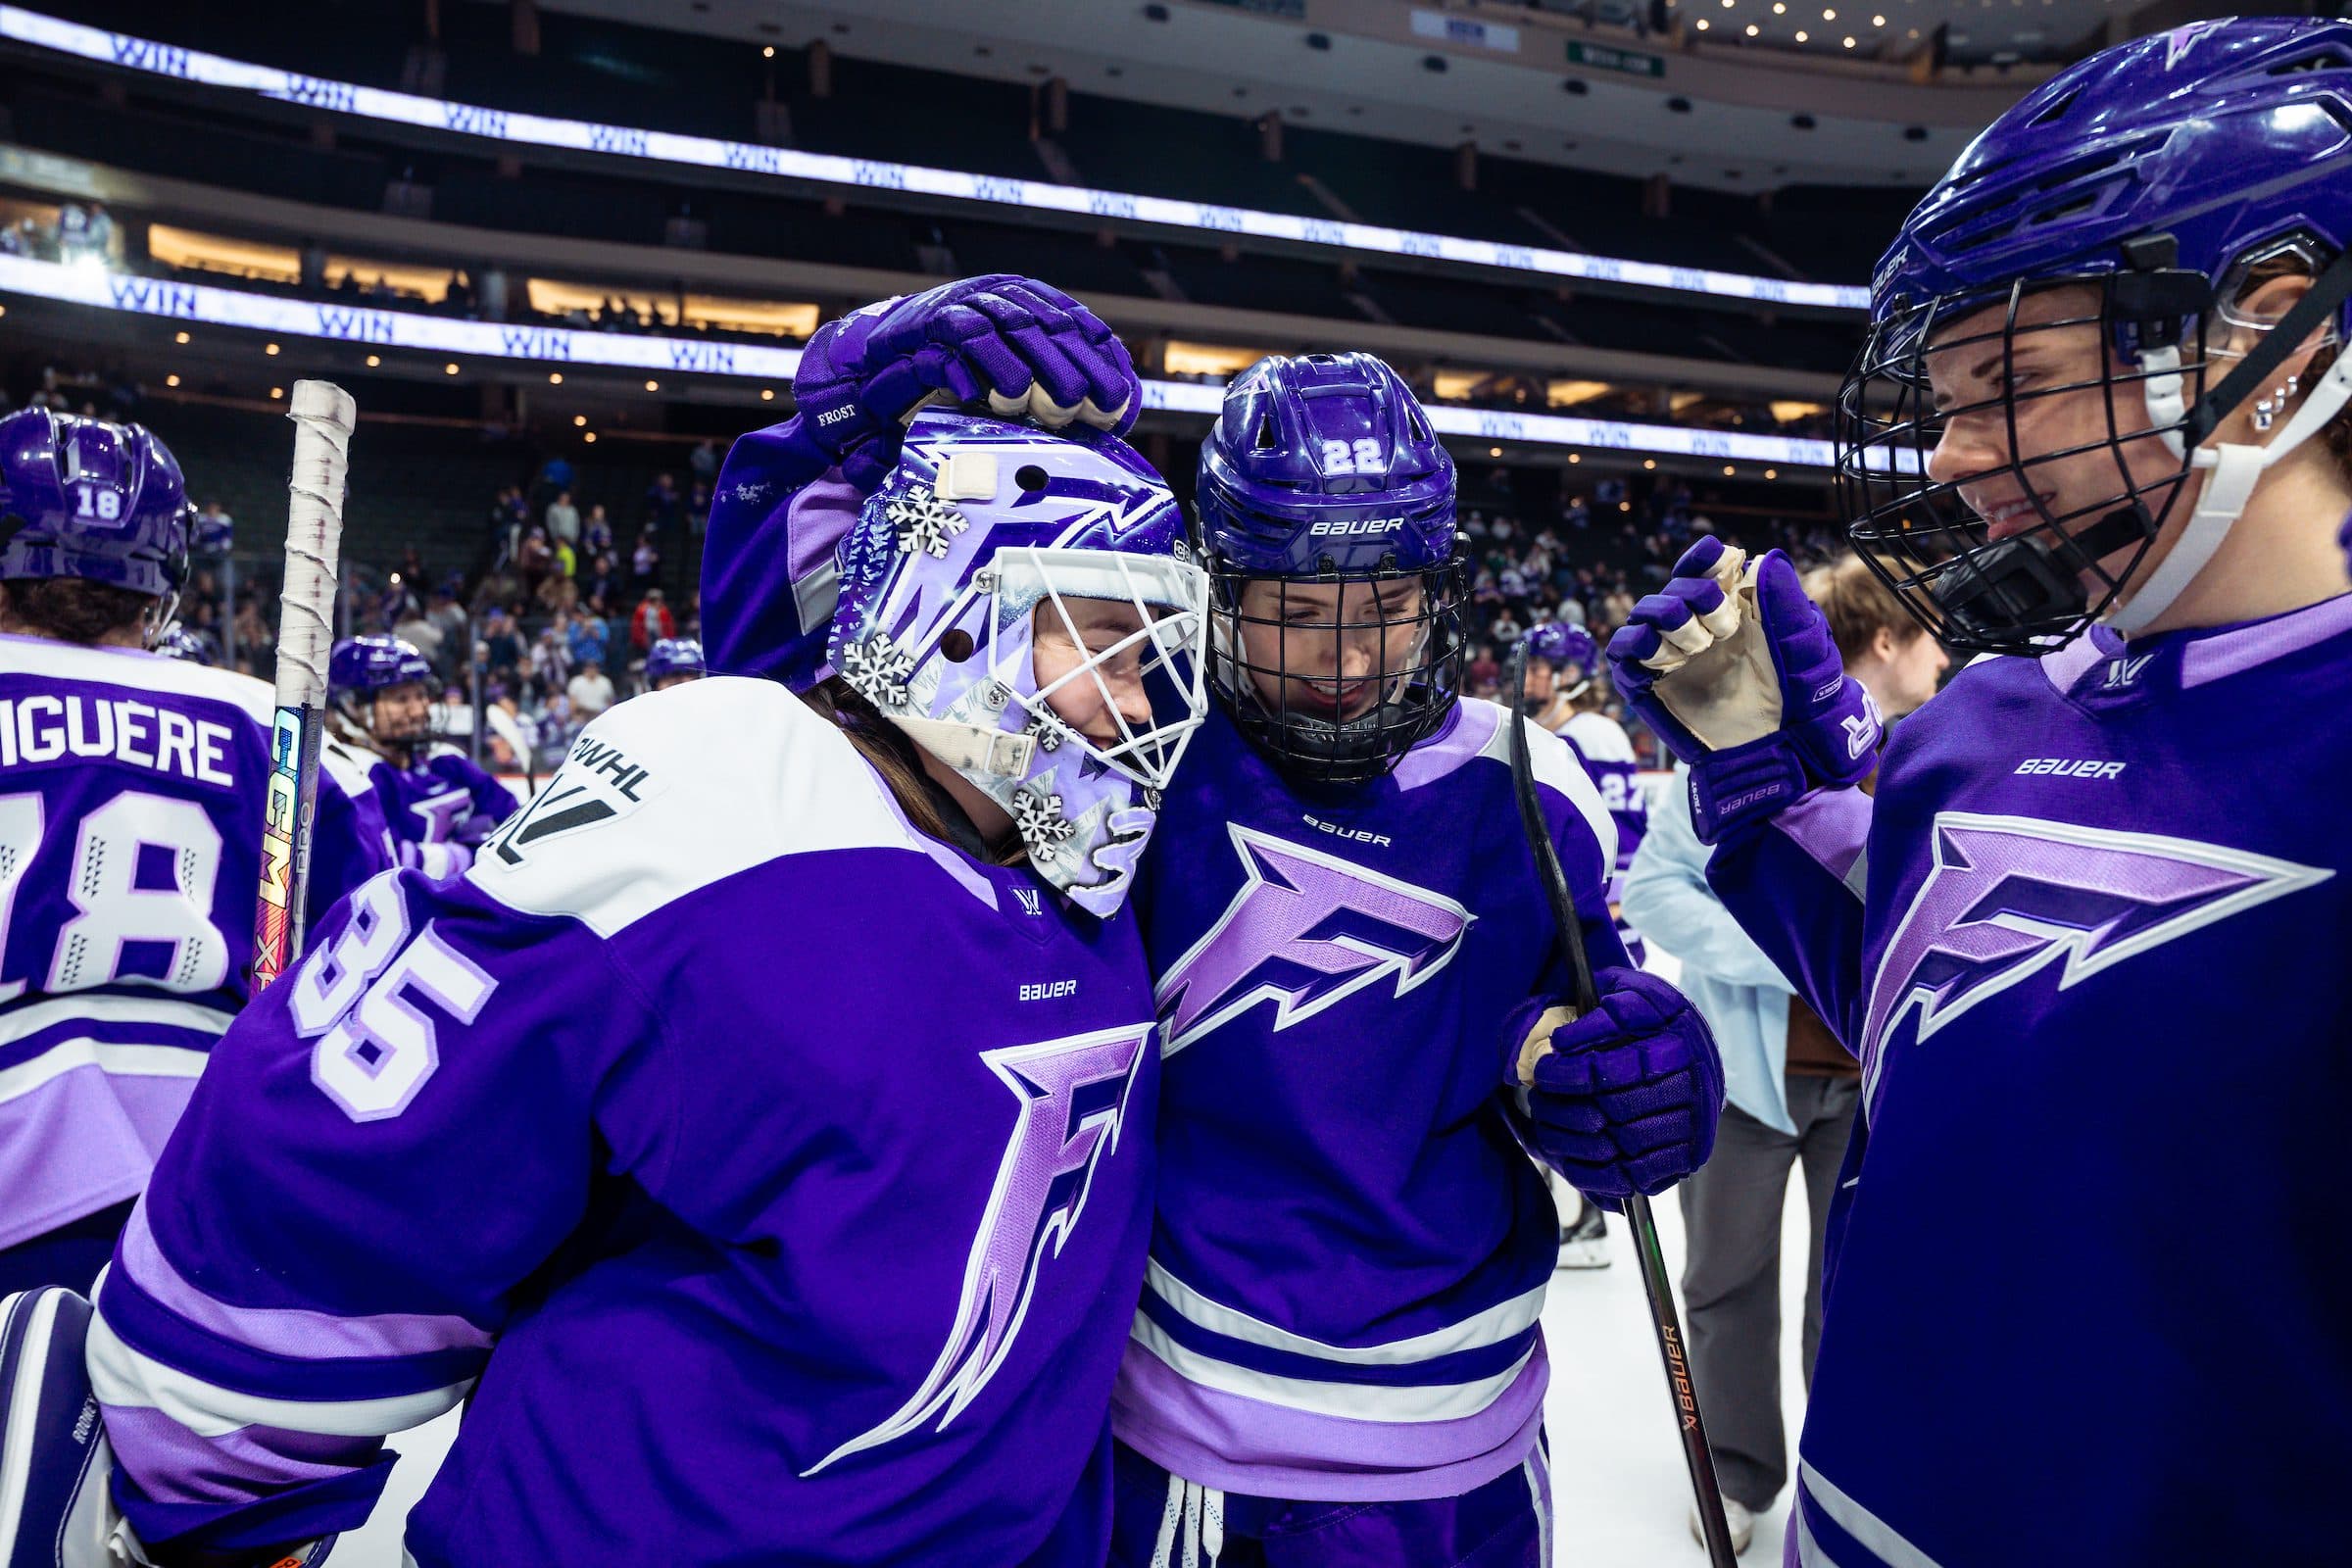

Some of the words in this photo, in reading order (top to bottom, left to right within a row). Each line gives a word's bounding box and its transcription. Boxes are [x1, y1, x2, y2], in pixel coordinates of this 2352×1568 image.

[111, 36, 189, 79] WIN
[288, 75, 356, 112] WIN
[443, 102, 507, 137] WIN
[588, 122, 648, 156] WIN
[724, 141, 780, 173] WIN
[853, 160, 905, 189] WIN
[973, 175, 1023, 206] WIN
[1872, 244, 1909, 296] AUER
[110, 280, 196, 318] WIN
[318, 303, 394, 343] WIN
[502, 325, 571, 361] WIN
[671, 340, 734, 374] WIN
[816, 404, 857, 427] FROST
[1322, 438, 1385, 475] 22
[76, 487, 121, 519] 18
[1309, 517, 1405, 536] BAUER
[2014, 759, 2127, 780] BAUER
[259, 707, 301, 909] CCM
[1600, 773, 1644, 811] 27
[1691, 781, 1702, 814] FROST
[1720, 784, 1781, 814] BAUER
[296, 802, 312, 874] PRO
[1302, 813, 1392, 848] BAUER
[1019, 979, 1077, 1002] BAUER
[1662, 1325, 1695, 1412] BAUER
